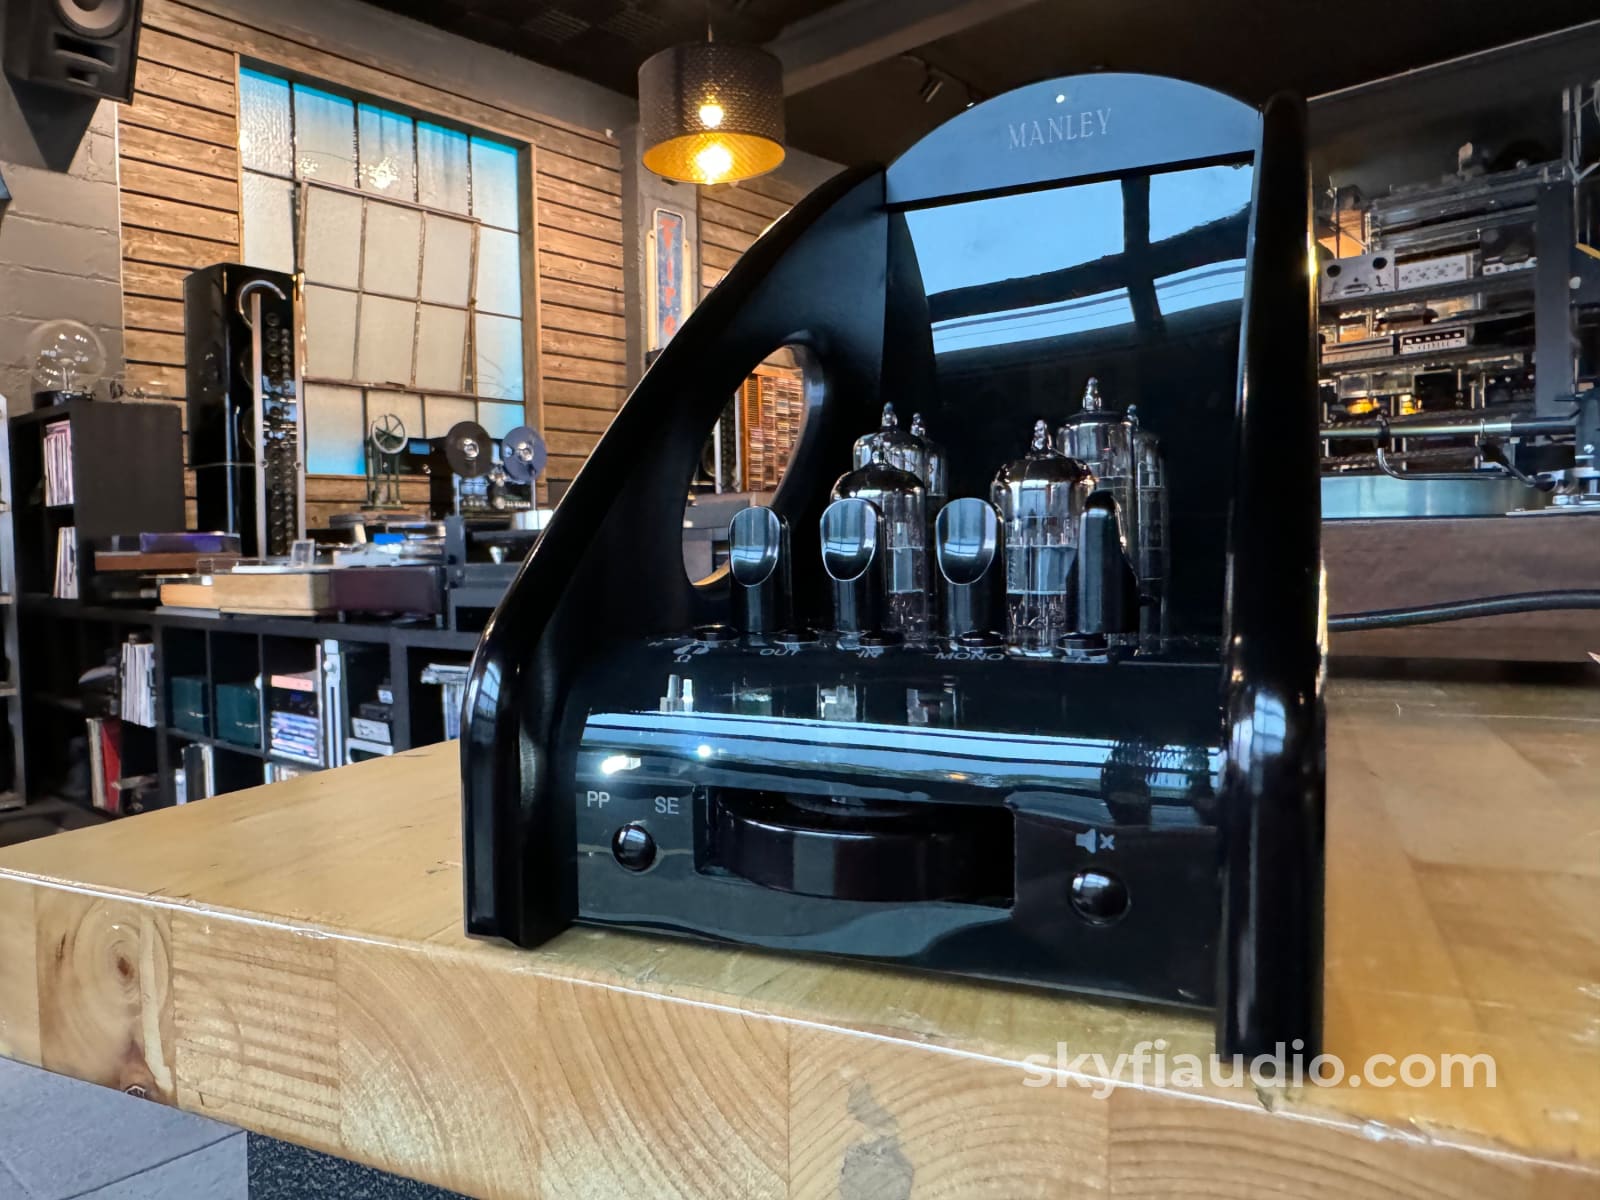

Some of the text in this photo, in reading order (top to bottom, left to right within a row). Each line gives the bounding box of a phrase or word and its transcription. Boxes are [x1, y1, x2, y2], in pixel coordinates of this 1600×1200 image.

[1008, 107, 1112, 150] MANLEY
[759, 647, 801, 656] OUT
[934, 652, 1005, 660] MONO
[586, 790, 610, 809] PP
[654, 796, 680, 815] SE
